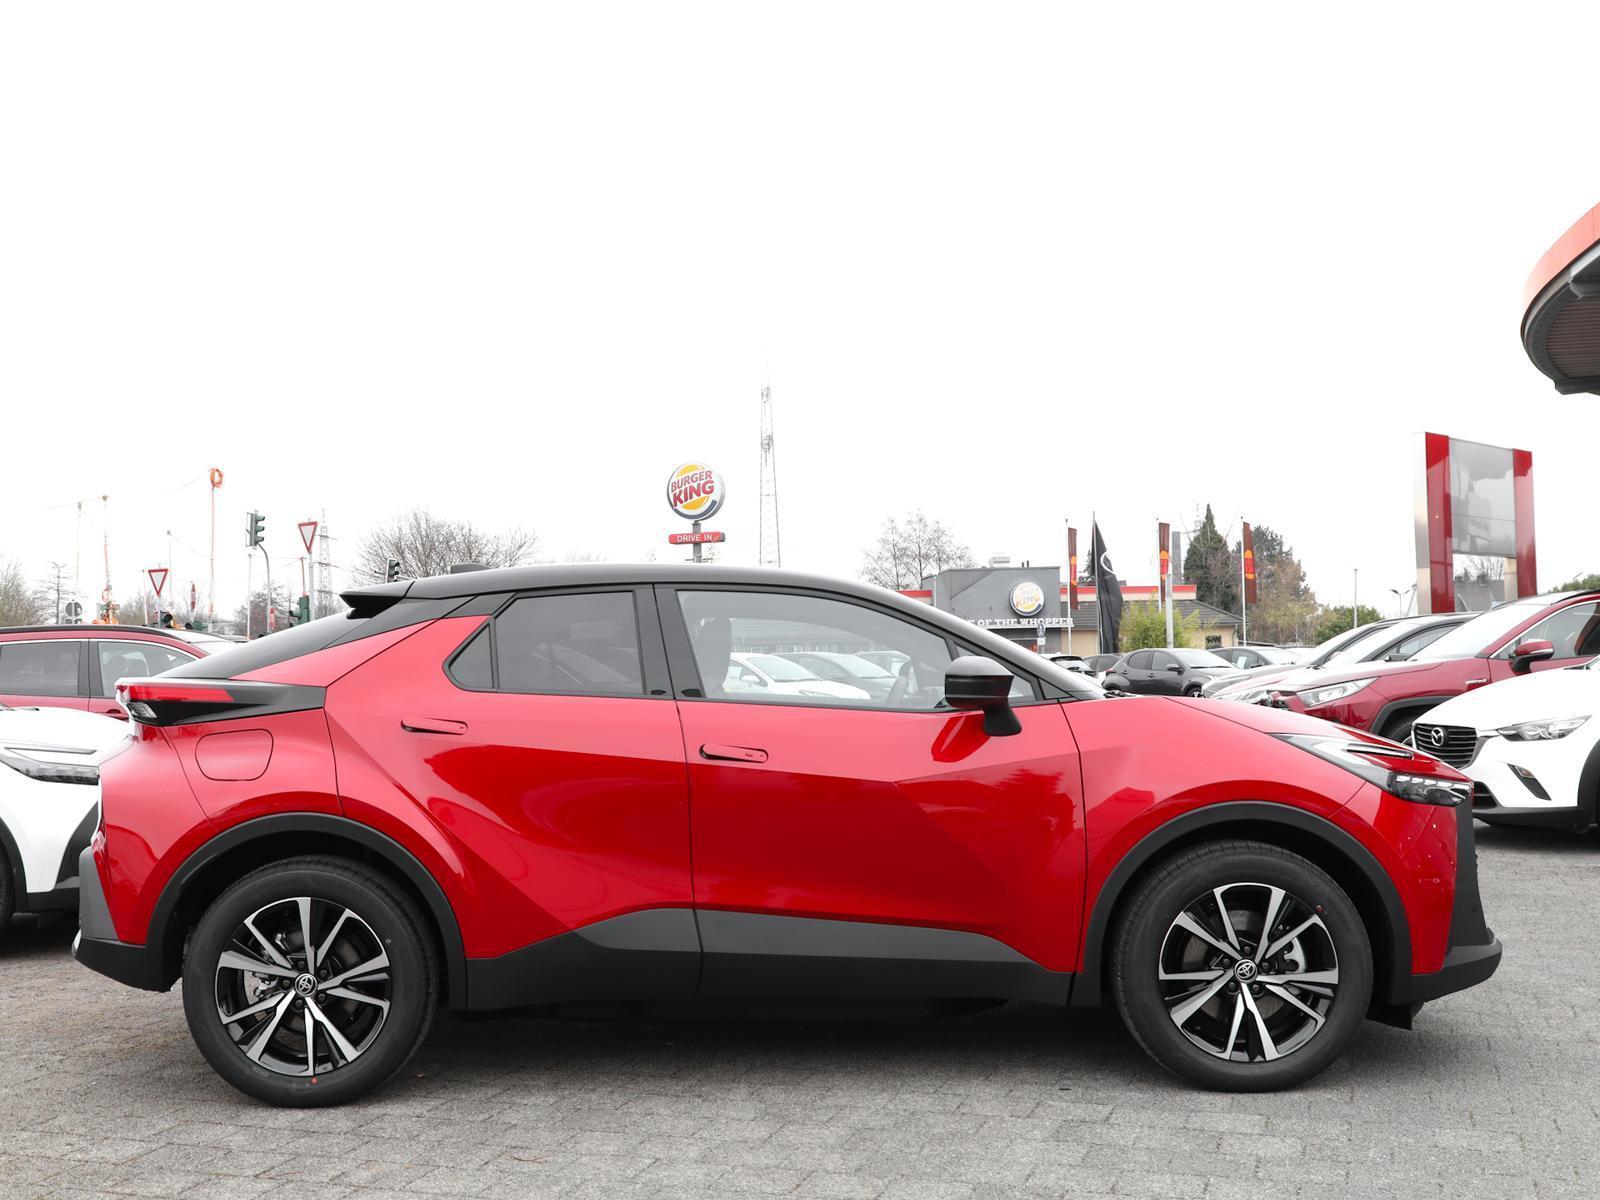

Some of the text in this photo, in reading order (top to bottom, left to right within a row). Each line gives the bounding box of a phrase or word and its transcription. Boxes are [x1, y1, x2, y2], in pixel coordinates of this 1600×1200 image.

[671, 470, 713, 494] BURGER
[672, 479, 715, 508] KING
[676, 535, 701, 543] DRIVE
[977, 618, 992, 627] OF
[993, 618, 1018, 627] THE
[1019, 617, 1074, 626] WHOPPER
